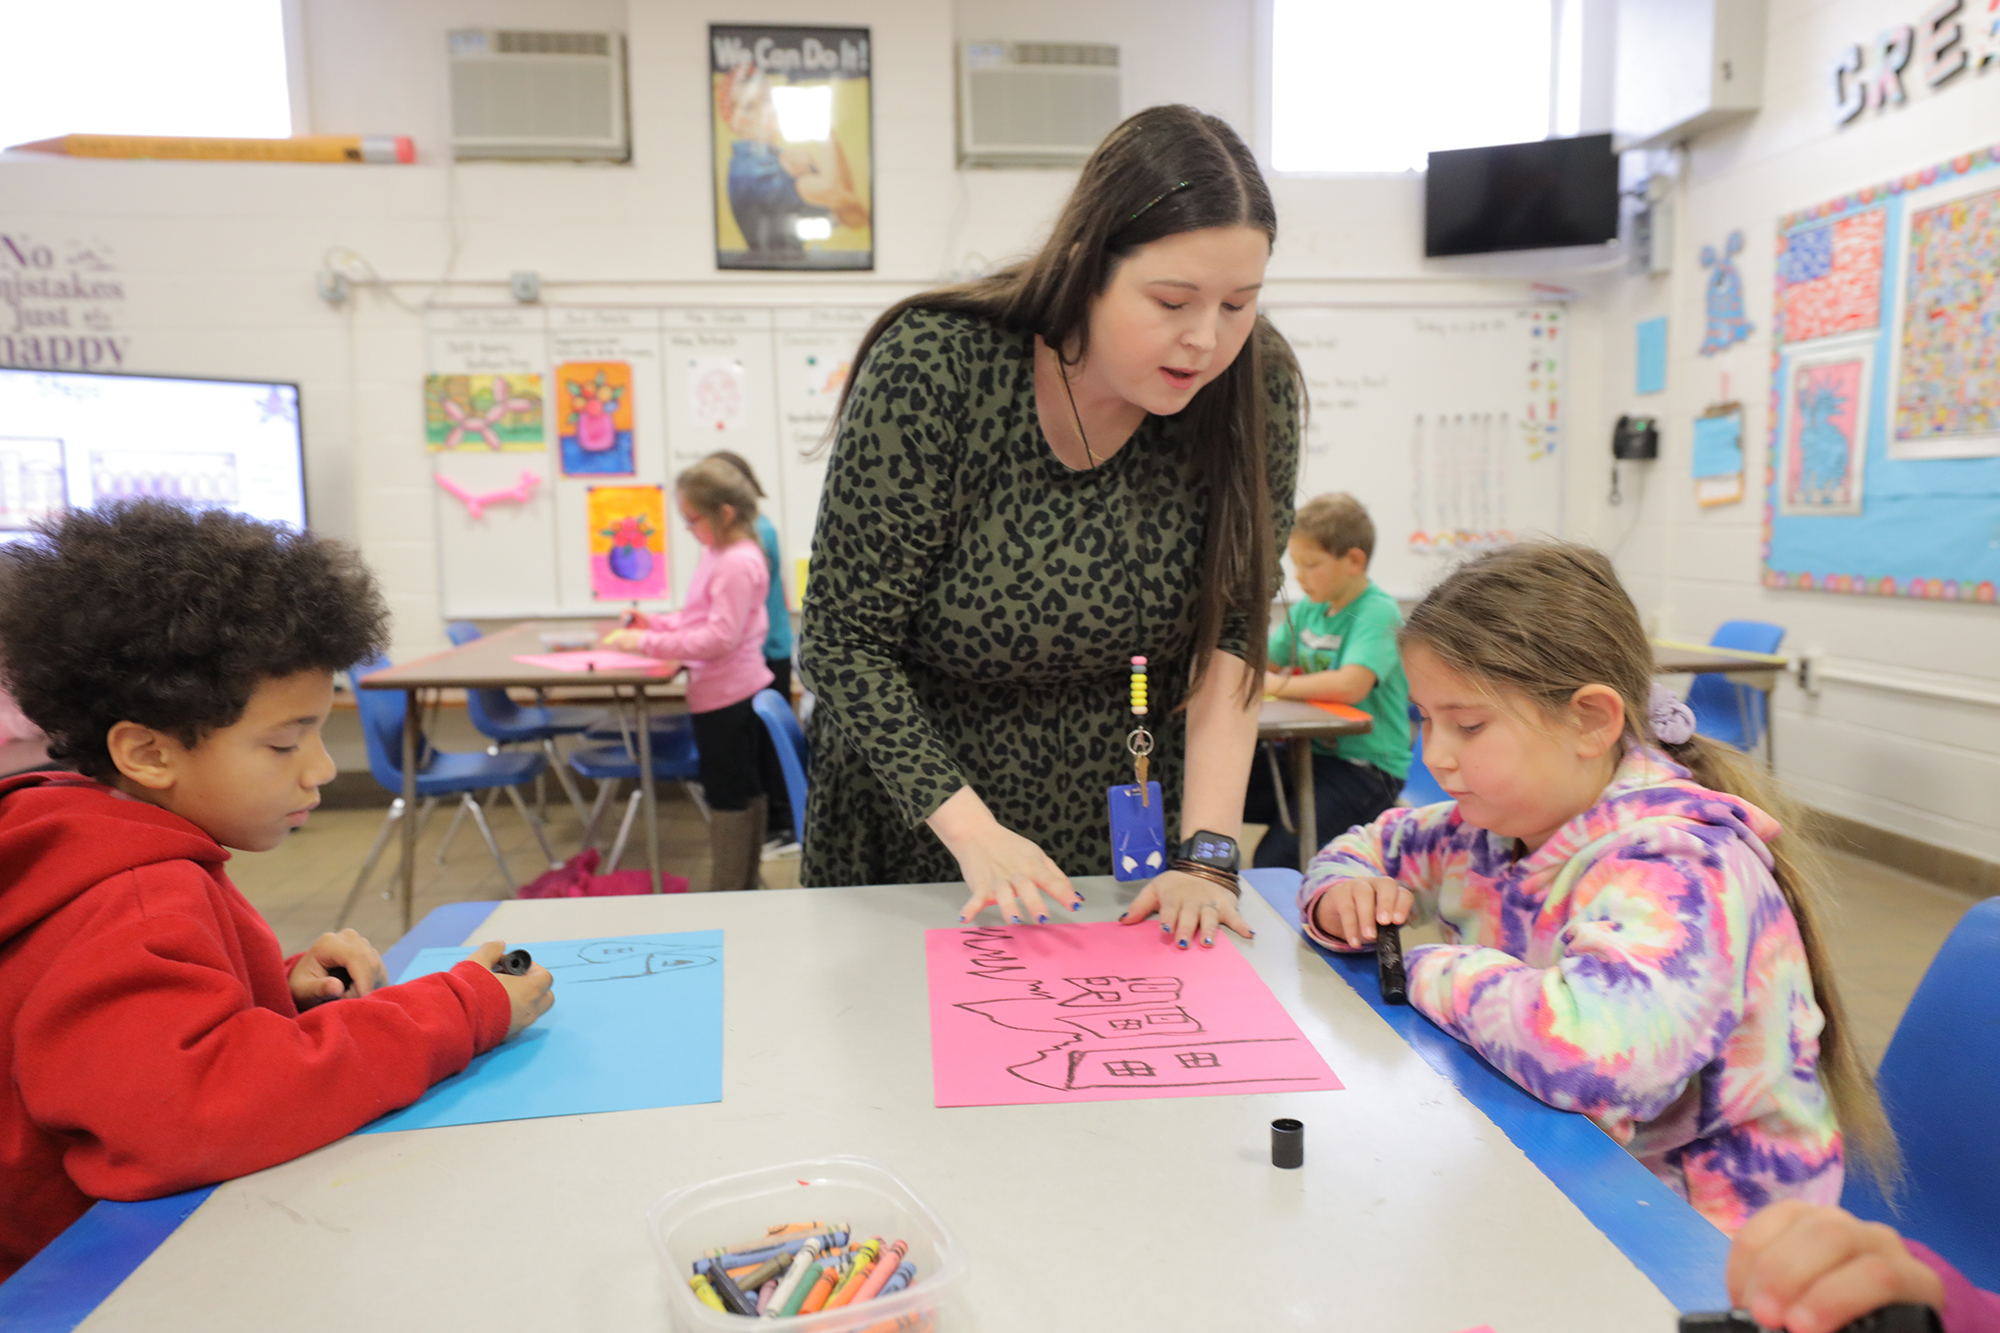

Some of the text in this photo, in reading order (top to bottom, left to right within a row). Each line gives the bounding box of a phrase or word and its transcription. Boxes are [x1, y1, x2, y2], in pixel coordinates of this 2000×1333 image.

[713, 36, 868, 71] We Can Do It!
[0, 234, 53, 270] No
